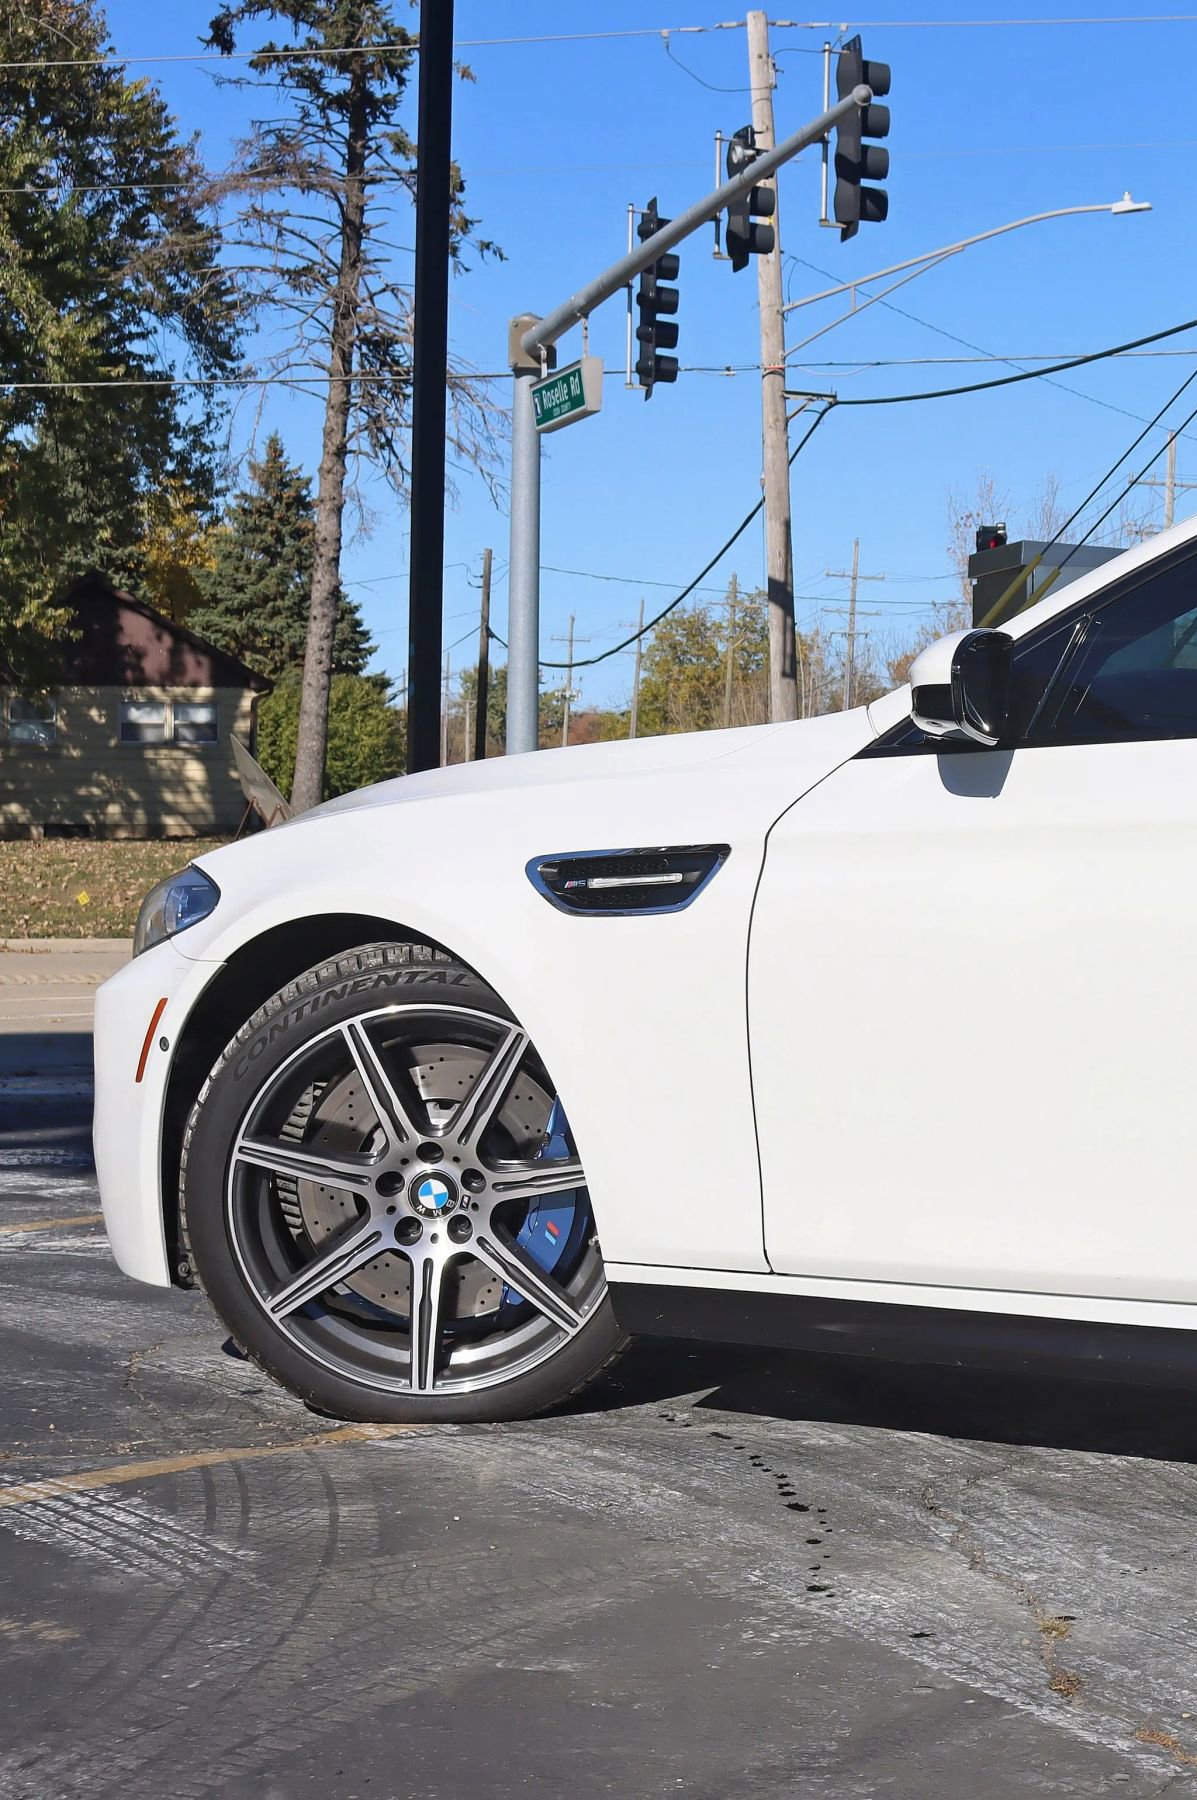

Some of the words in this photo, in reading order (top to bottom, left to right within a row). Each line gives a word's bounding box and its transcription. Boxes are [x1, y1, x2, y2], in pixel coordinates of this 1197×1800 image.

[542, 380, 569, 410] Roselle
[570, 371, 581, 397] Rd
[232, 970, 470, 1082] CONTINENTAL
[416, 1199, 456, 1216] BMW
